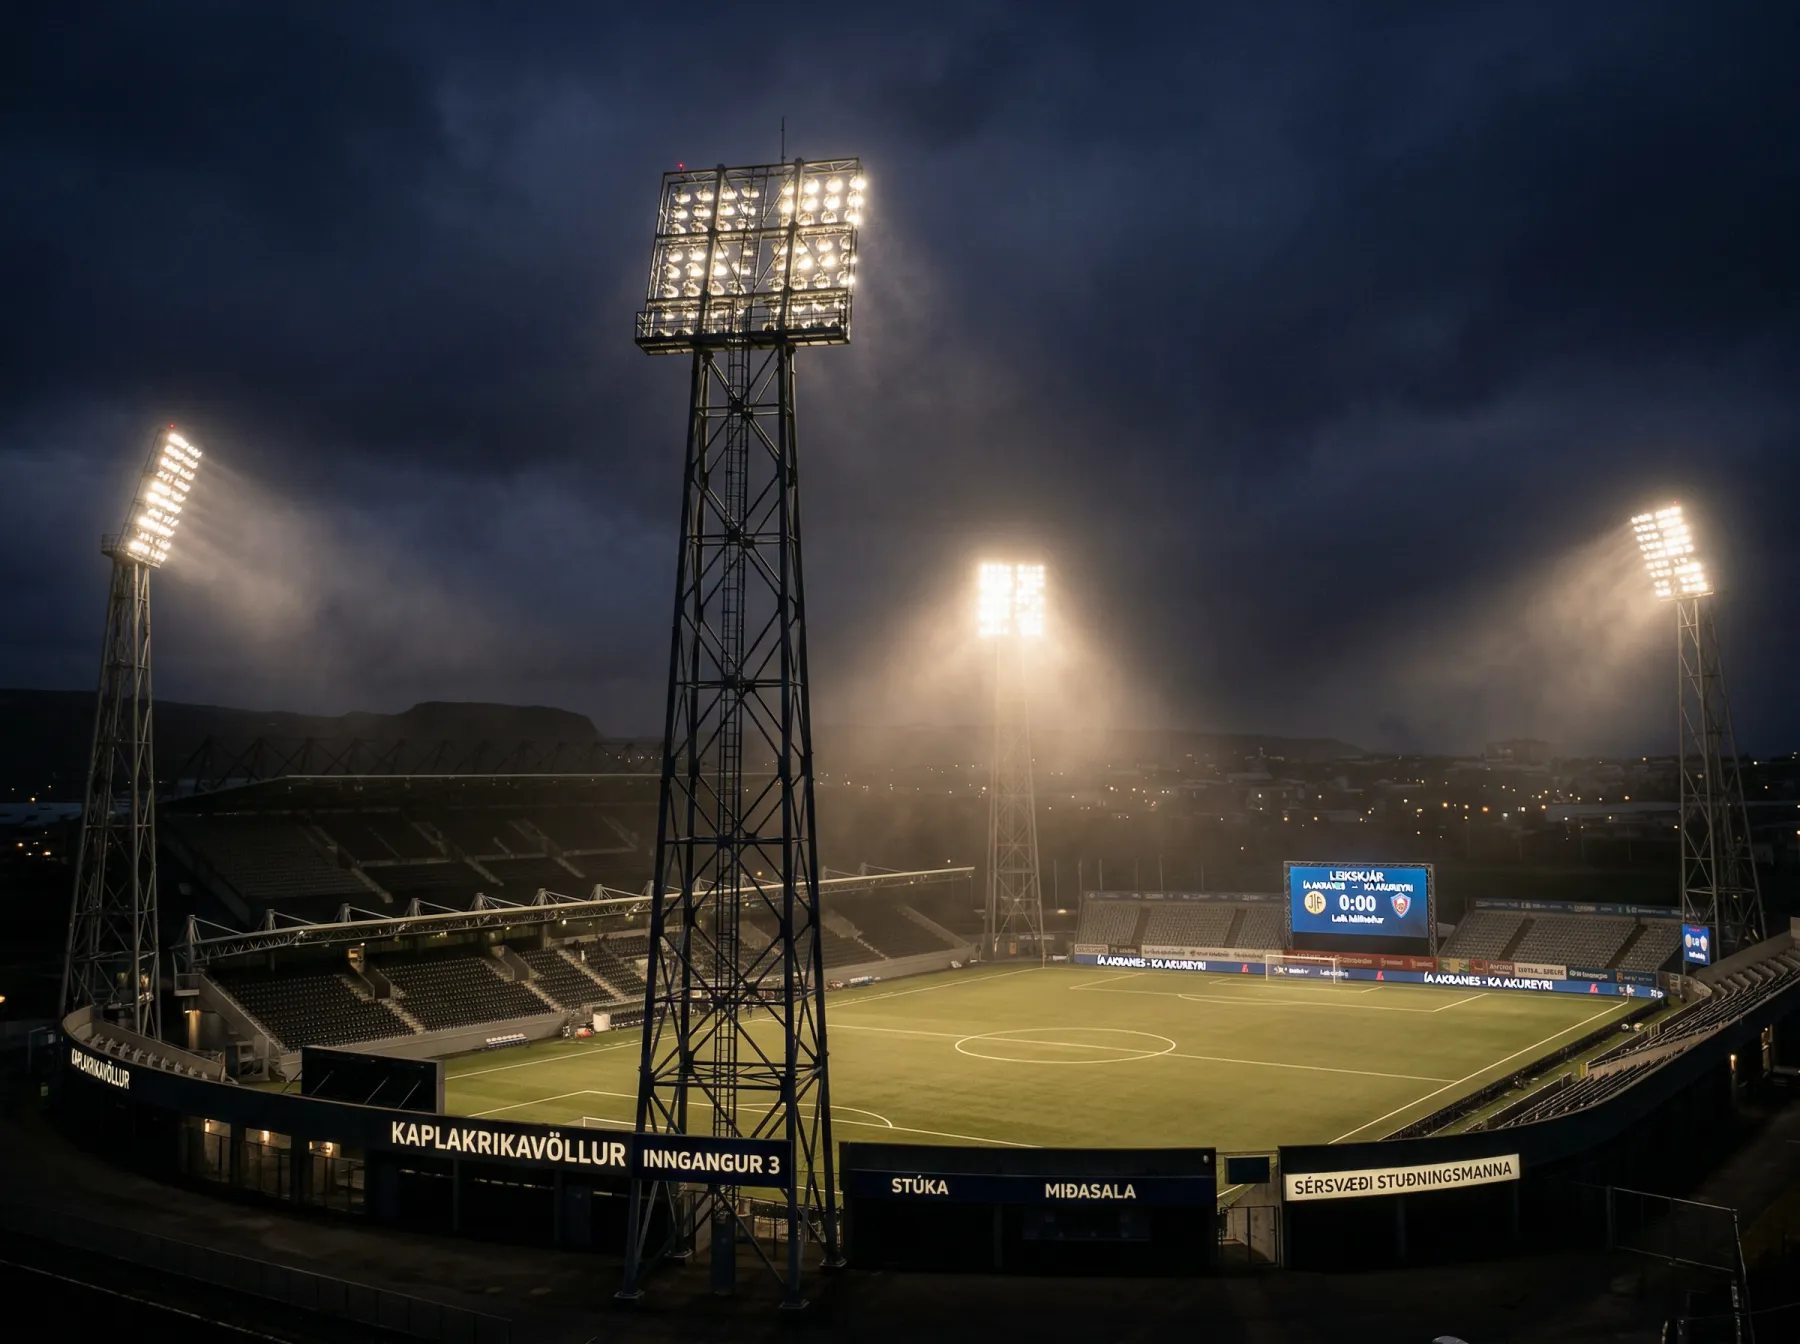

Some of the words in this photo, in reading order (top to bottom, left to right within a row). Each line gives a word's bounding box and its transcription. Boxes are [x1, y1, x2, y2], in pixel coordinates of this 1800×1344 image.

[1339, 894, 1376, 912] 0:00
[1435, 974, 1480, 986] AKRANES
[1488, 976, 1502, 988] KA
[1503, 978, 1553, 990] AKUREYRI
[391, 1121, 626, 1167] KAPLAKRIKAVÖLLUR
[643, 1149, 763, 1174] INNGANGUR
[768, 1155, 780, 1175] 3
[891, 1175, 949, 1195] STÚKA
[1294, 1175, 1373, 1195] SÉRSVÆÐI
[1377, 1161, 1512, 1189] STUÐNINGSMANNA
[1045, 1183, 1136, 1199] MIÐASALA
